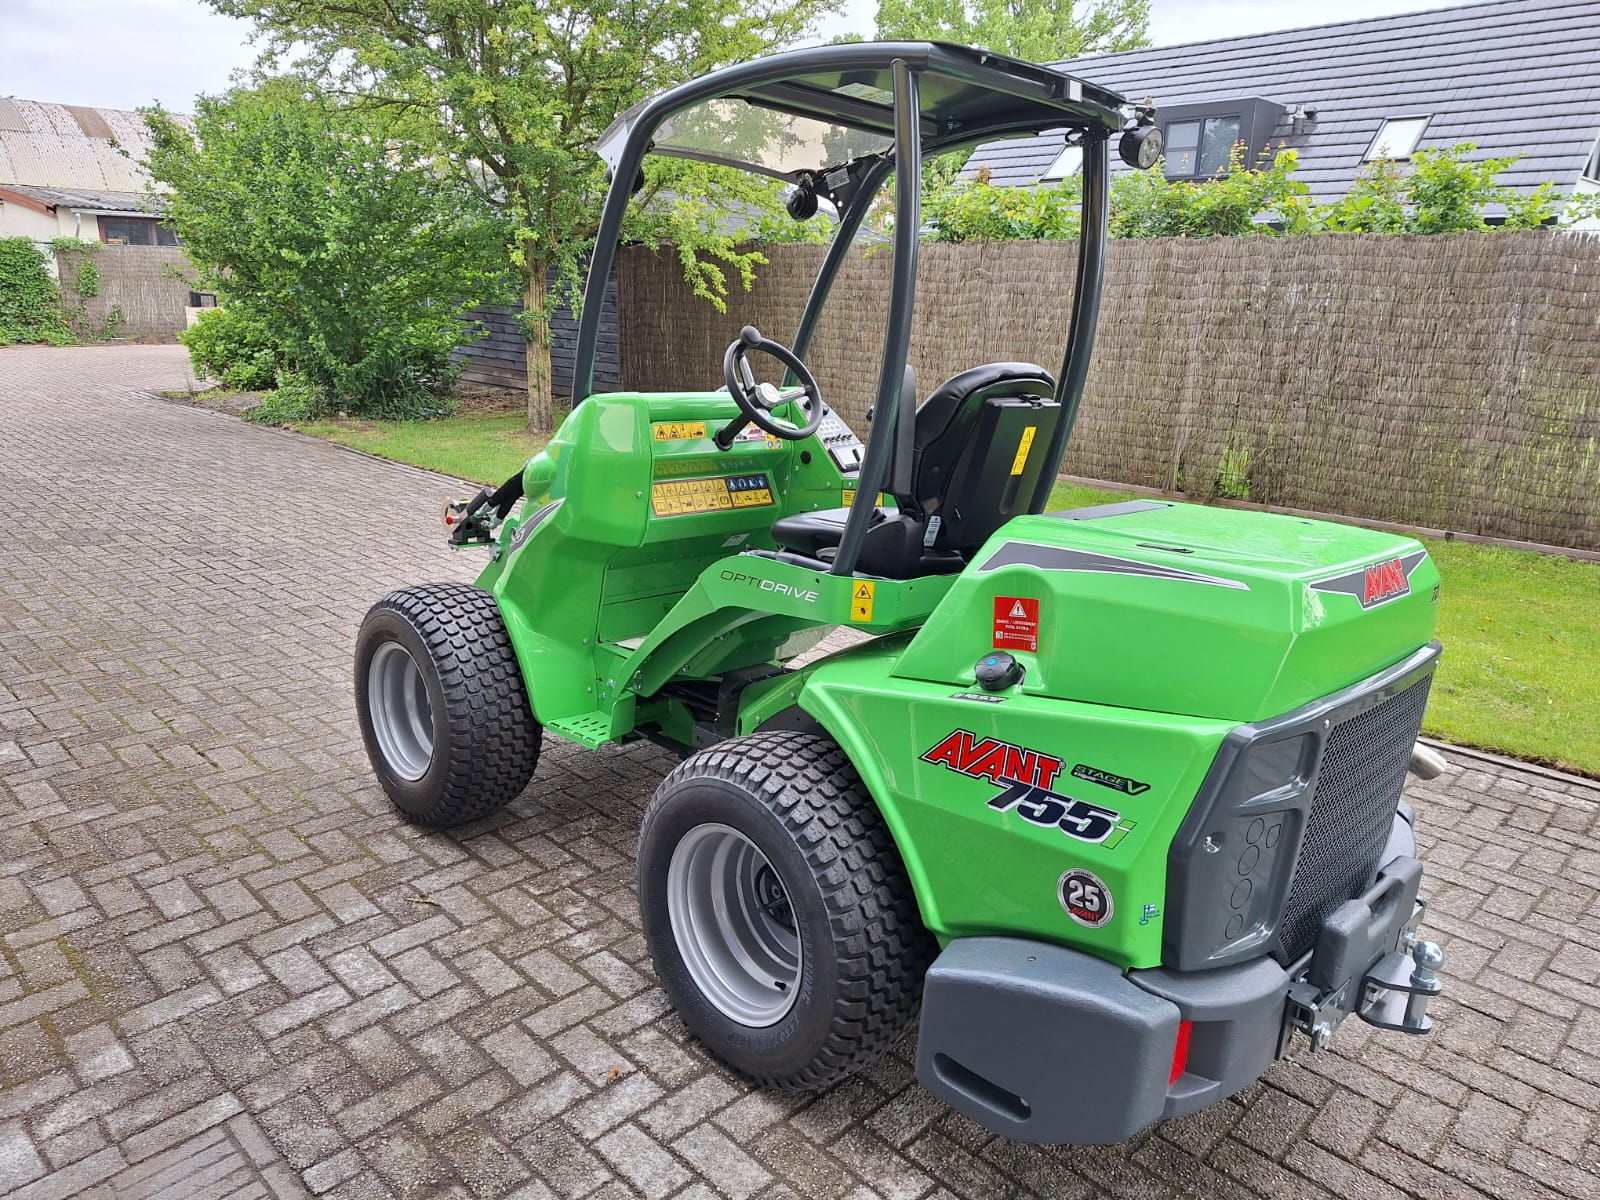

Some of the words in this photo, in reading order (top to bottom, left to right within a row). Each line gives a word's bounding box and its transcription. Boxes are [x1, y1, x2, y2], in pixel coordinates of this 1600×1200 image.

[720, 569, 819, 603] OPTIDRIVE
[918, 728, 1063, 793] AVANT
[1075, 765, 1126, 786] STAGE
[1127, 780, 1148, 794] V
[1069, 880, 1100, 912] 25
